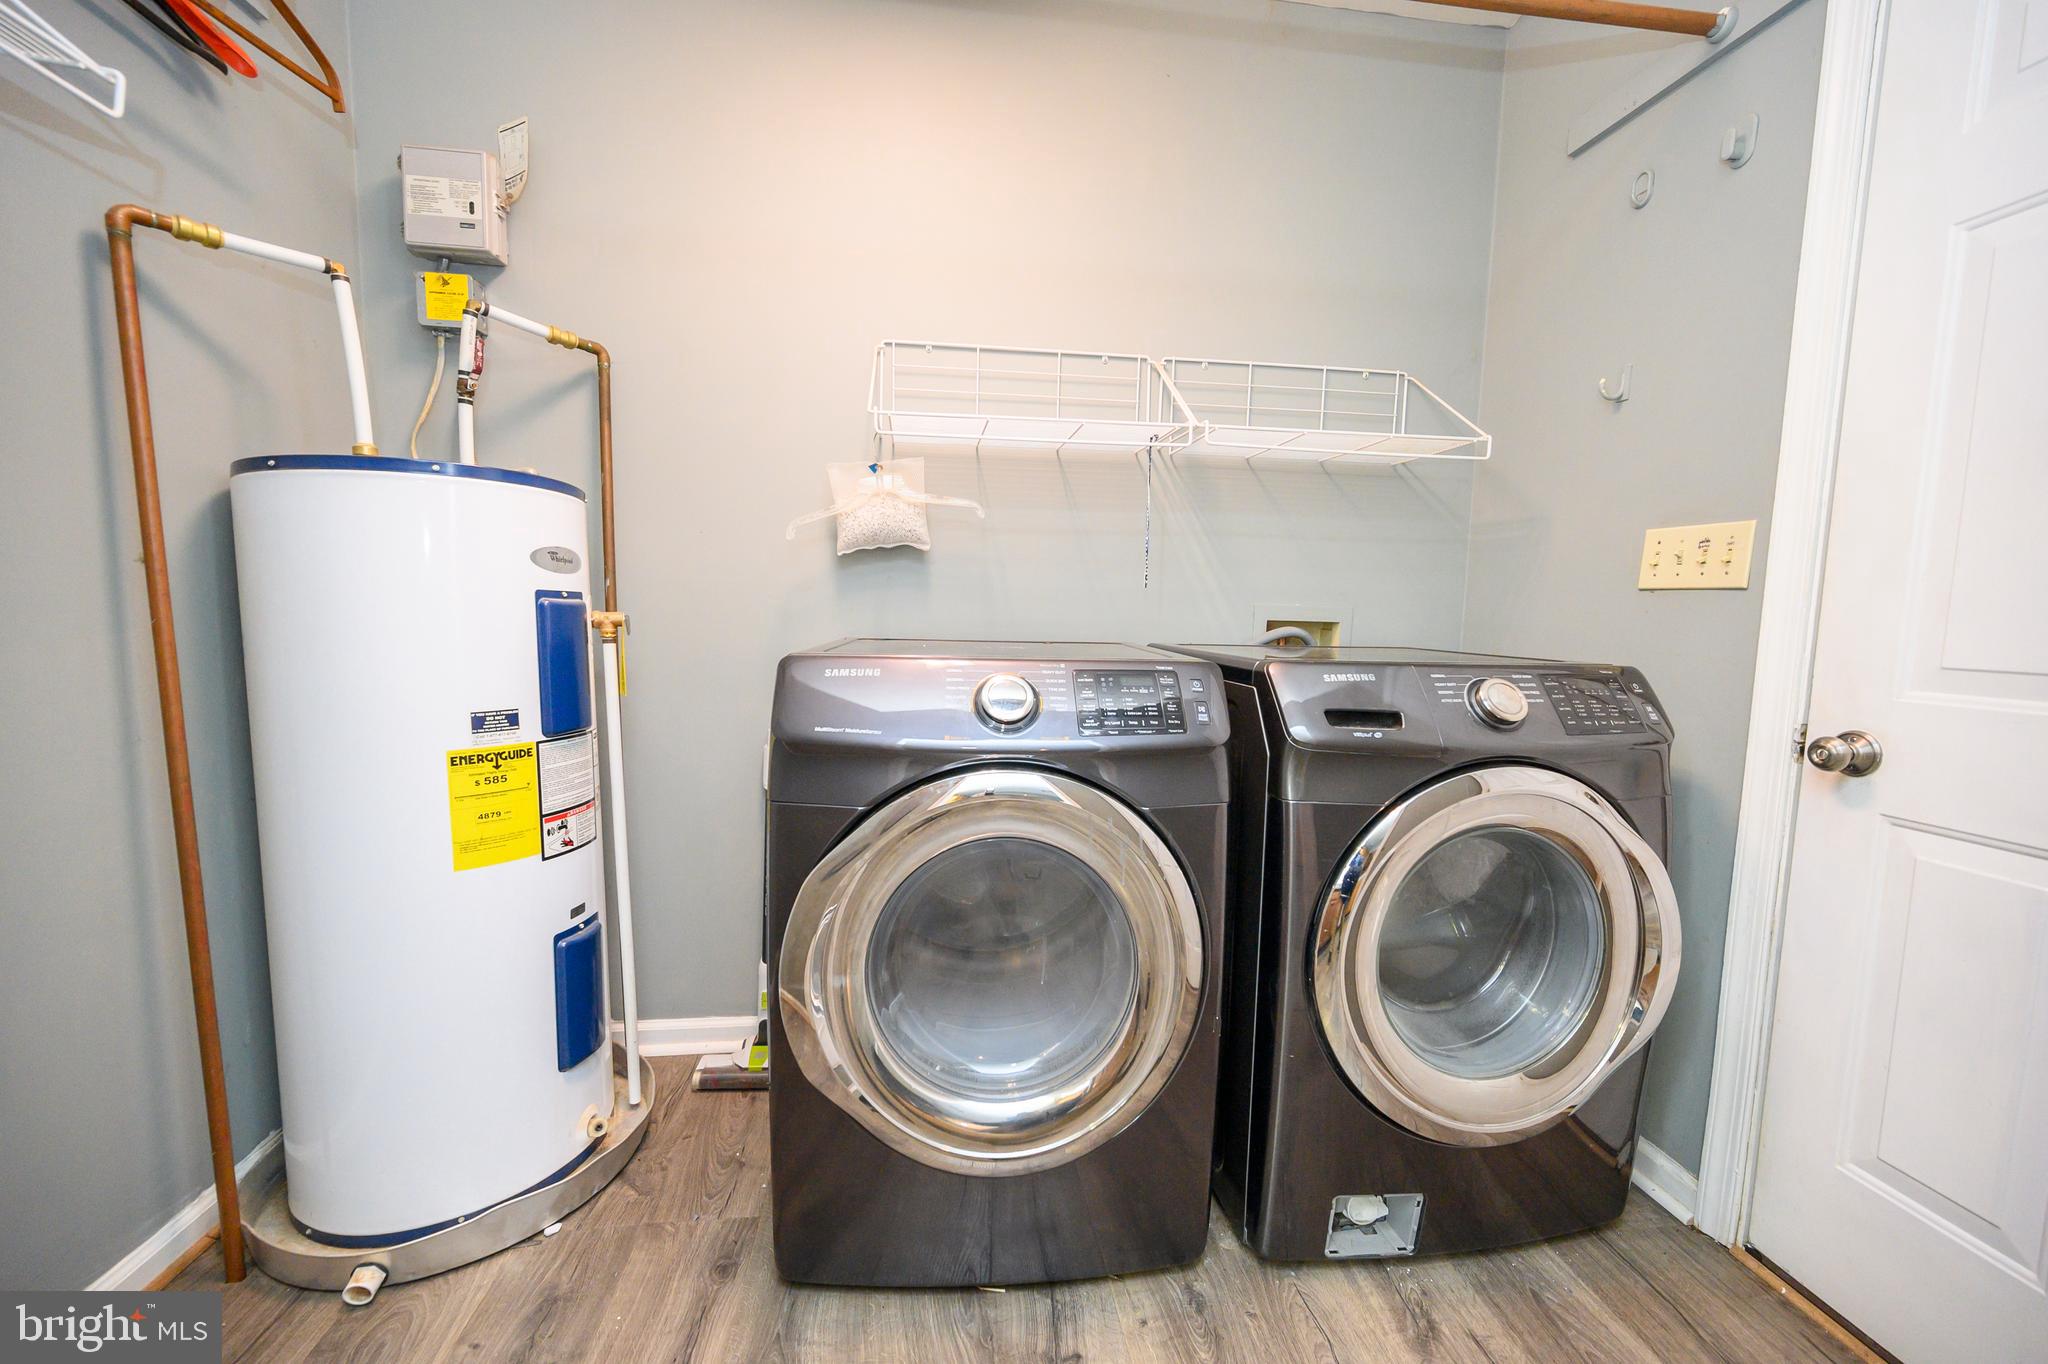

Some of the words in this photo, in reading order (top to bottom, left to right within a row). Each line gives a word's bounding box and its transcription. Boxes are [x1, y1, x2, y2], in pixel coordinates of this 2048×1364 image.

[824, 668, 881, 677] SAMSUNG
[1323, 673, 1376, 682] SAMSUNG
[450, 748, 533, 767] ENERGYGUIDE
[484, 774, 508, 785] 585
[477, 810, 501, 820] 4879
